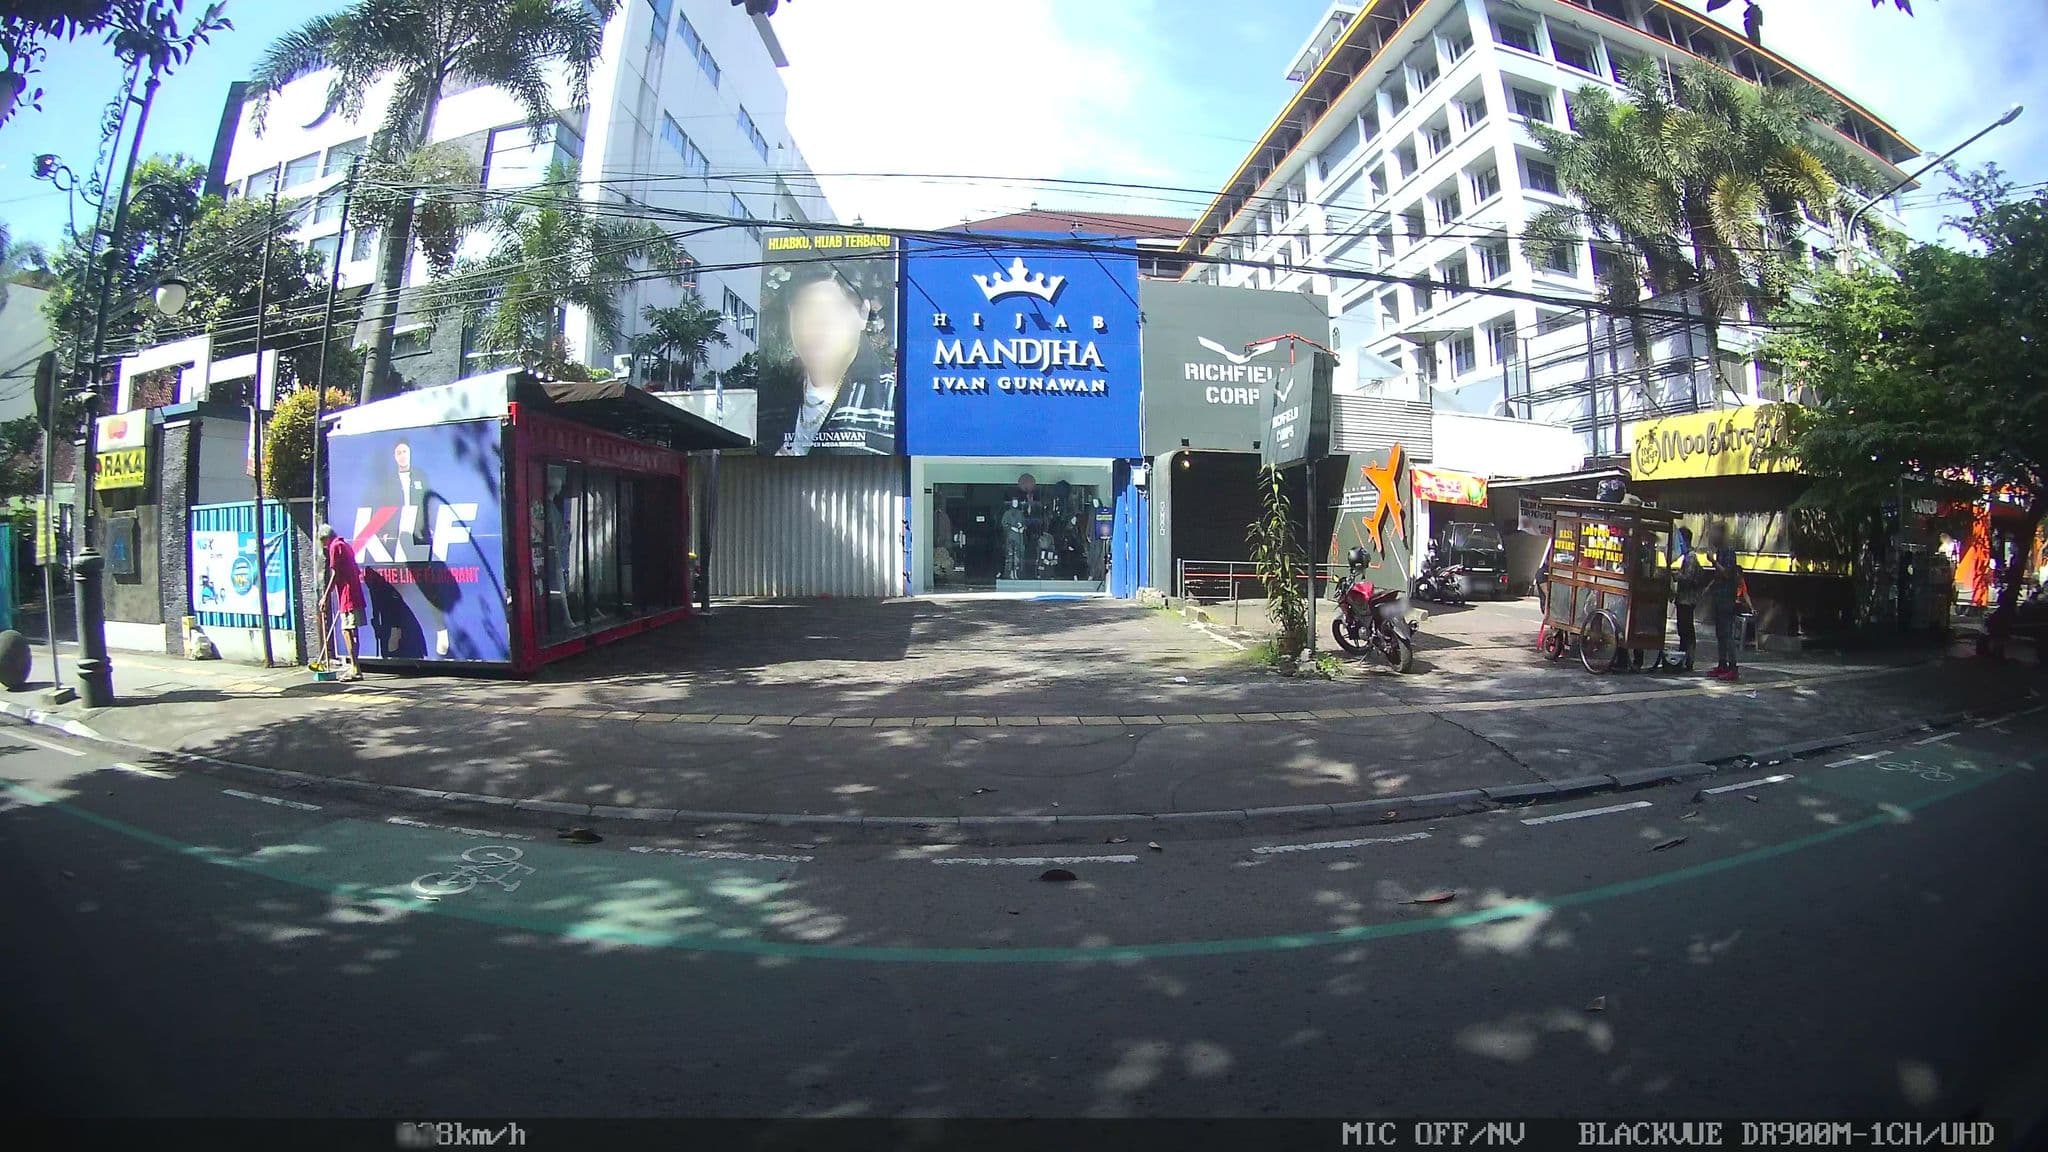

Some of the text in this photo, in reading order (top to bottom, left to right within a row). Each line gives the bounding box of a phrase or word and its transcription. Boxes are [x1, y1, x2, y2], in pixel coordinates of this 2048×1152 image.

[814, 235, 842, 248] HIJAB
[844, 234, 891, 248] TERBARU
[932, 338, 1105, 372] MANDJHA
[932, 376, 1106, 392] IVAN GUNAWAN
[352, 502, 479, 563] KLF
